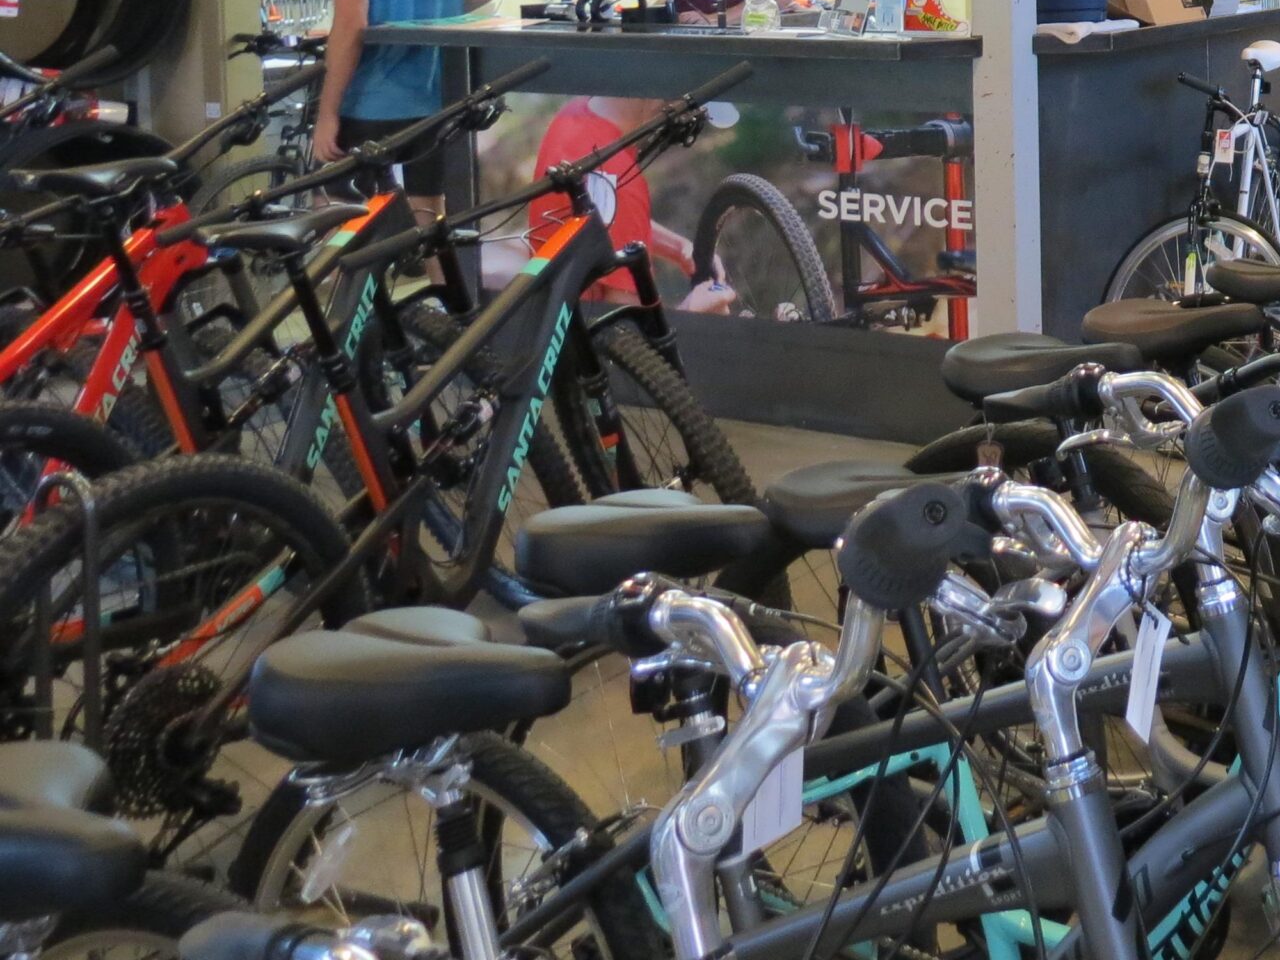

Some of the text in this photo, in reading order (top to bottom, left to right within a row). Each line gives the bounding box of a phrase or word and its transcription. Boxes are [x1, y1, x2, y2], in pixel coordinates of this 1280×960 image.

[817, 189, 974, 230] SERVICE
[498, 301, 574, 512] SANTA CRUZ
